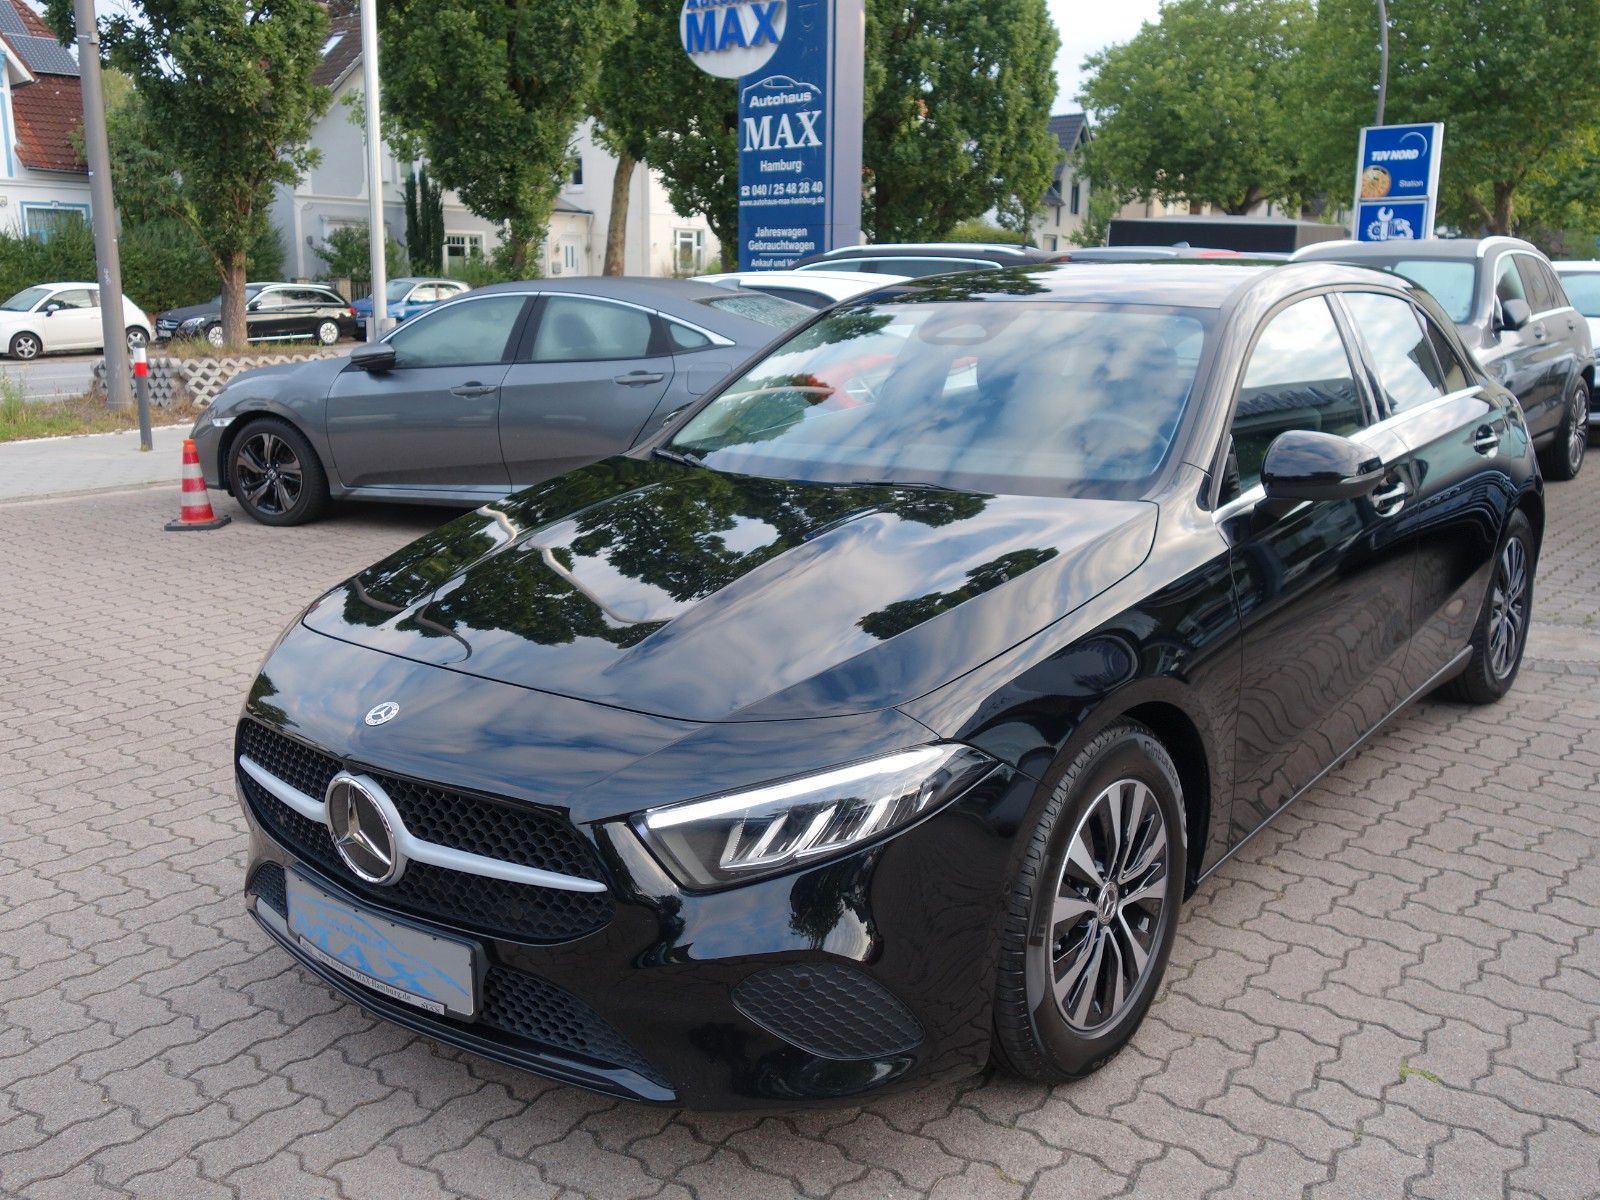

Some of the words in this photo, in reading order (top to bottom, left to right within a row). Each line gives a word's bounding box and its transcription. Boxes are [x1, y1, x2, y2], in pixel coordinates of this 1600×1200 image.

[686, 1, 780, 54] MAX
[749, 92, 812, 108] Autohaus
[743, 110, 822, 151] MAX
[1390, 149, 1419, 160] NORD
[760, 159, 802, 173] Hamburg
[751, 184, 767, 196] 040
[773, 183, 785, 195] 25
[786, 182, 798, 194] 48
[798, 181, 810, 194] 28
[811, 181, 823, 193] 40
[1399, 179, 1424, 188] Station
[755, 226, 808, 239] Jahreswagen
[747, 239, 815, 252] Gebrauchtwagen
[751, 258, 773, 267] Ankauf
[773, 258, 786, 267] und
